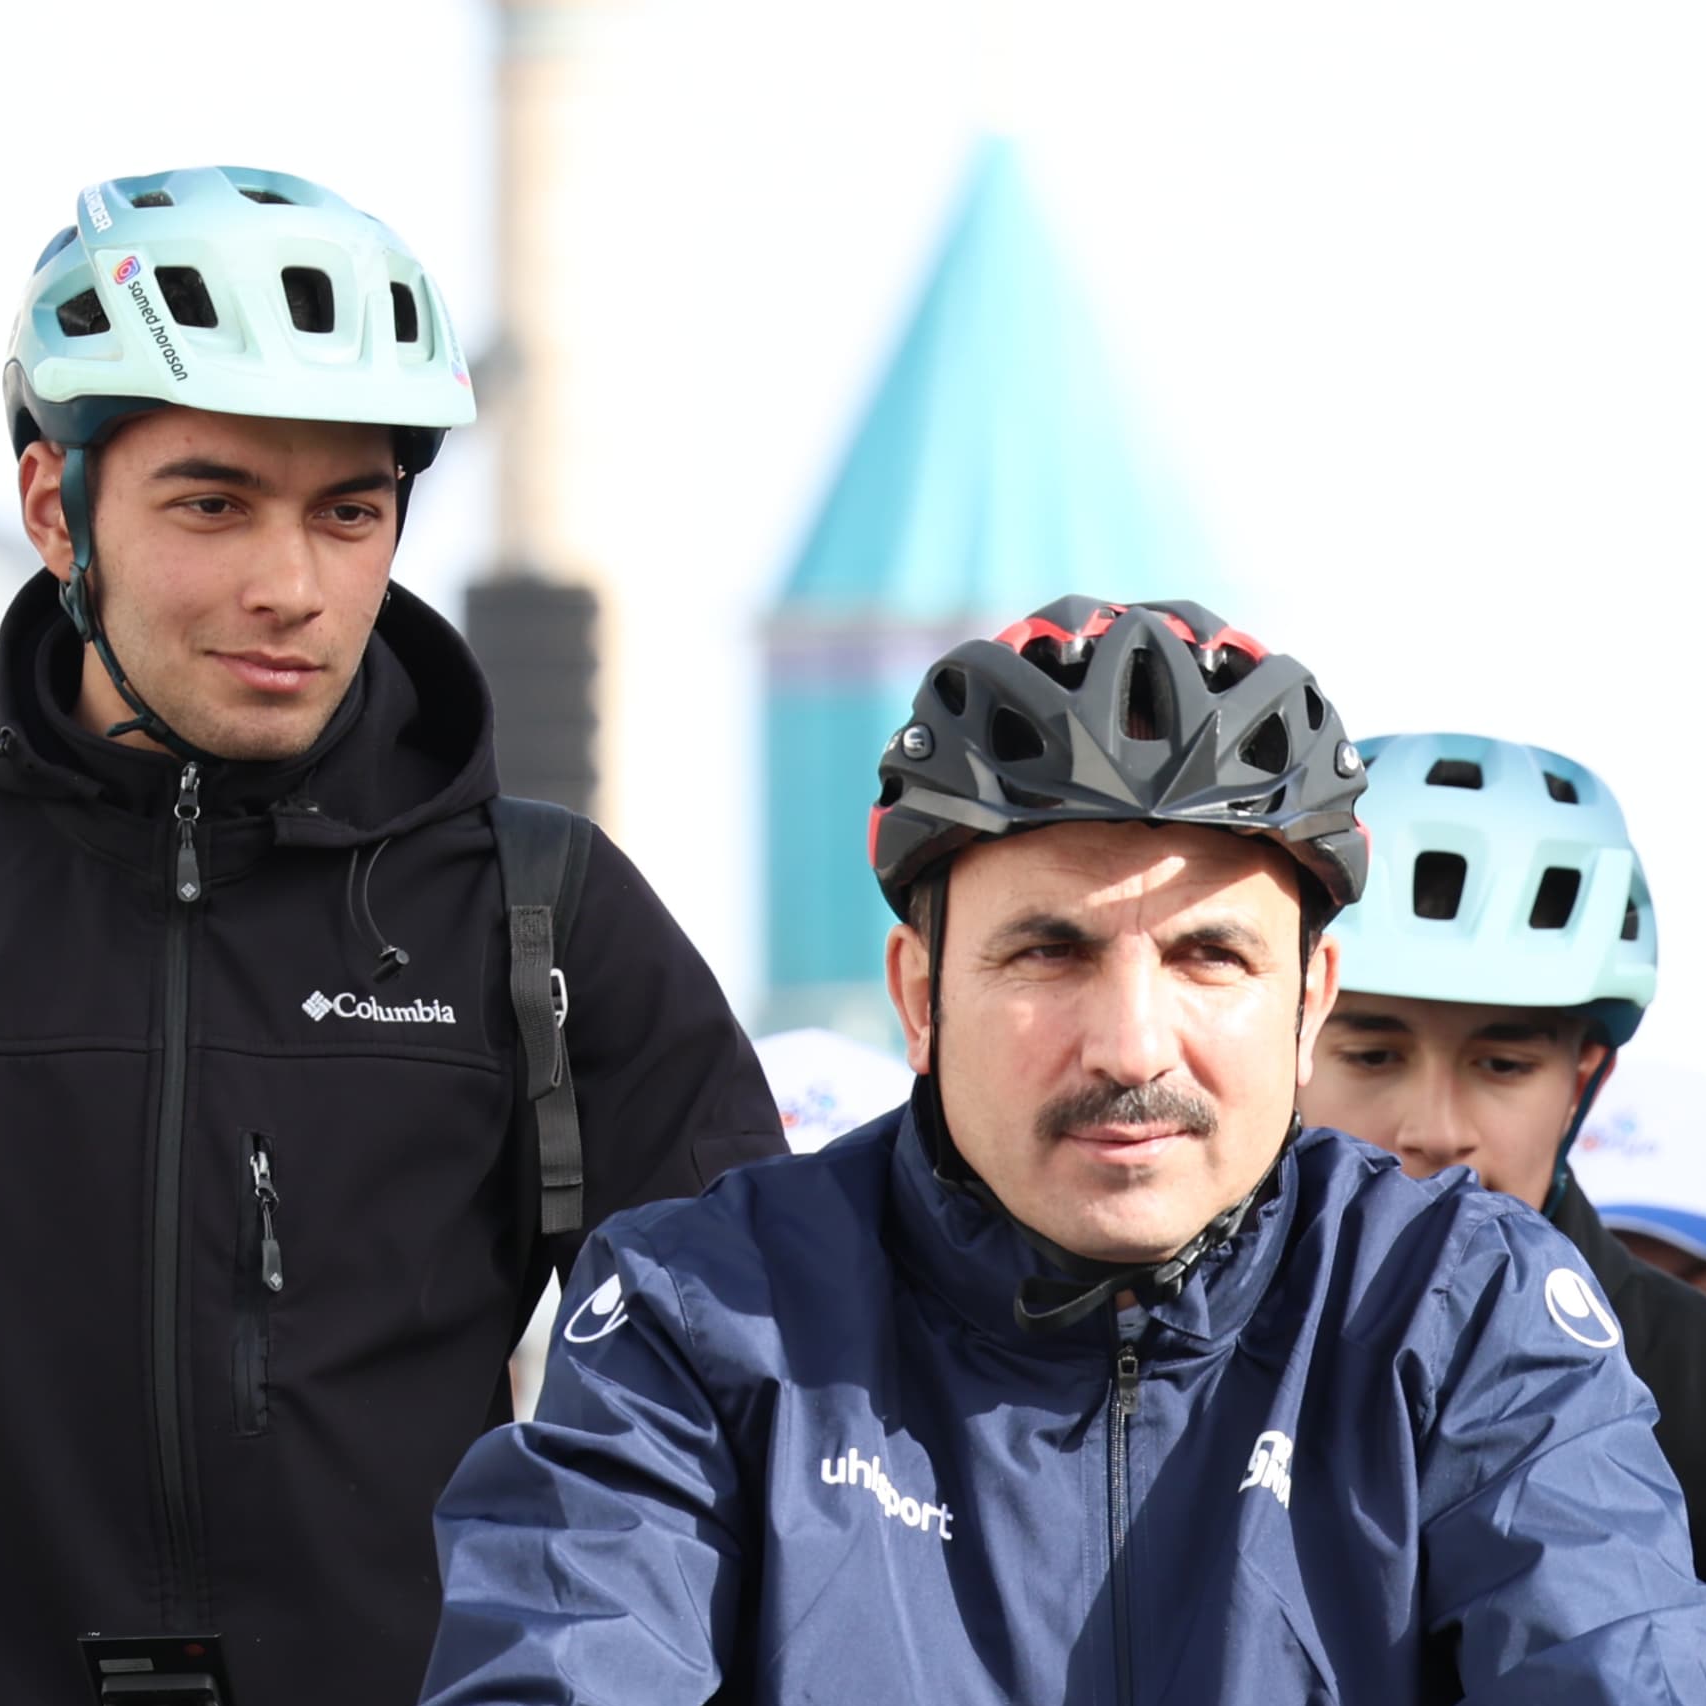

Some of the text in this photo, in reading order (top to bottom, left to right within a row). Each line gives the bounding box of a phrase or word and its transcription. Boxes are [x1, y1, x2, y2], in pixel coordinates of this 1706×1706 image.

[127, 280, 189, 382] samed.horasan
[332, 991, 457, 1025] Columbia
[820, 1447, 954, 1541] uhlsport
